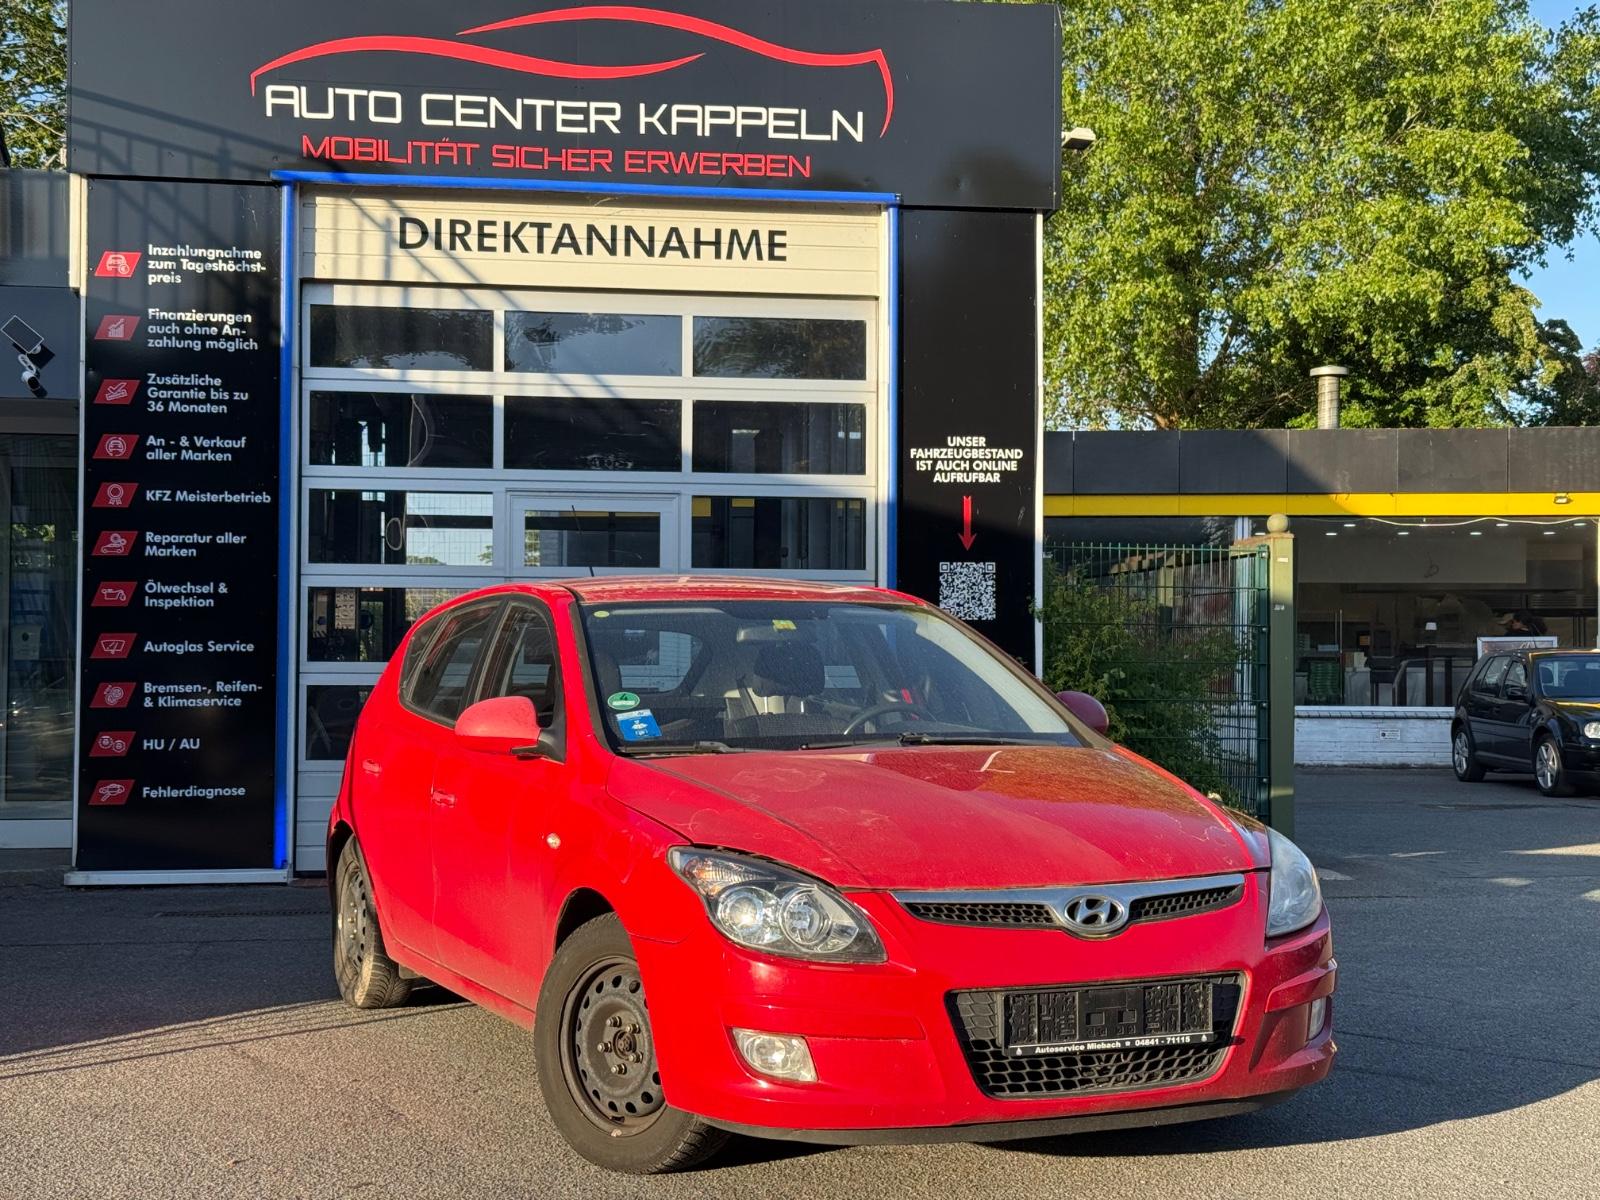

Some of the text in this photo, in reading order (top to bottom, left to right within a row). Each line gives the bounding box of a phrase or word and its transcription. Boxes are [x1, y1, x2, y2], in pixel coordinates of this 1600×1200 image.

[265, 84, 864, 142] AUTO CENTER KAPPELN
[302, 135, 810, 178] MOBILITÄT SICHER ERWERBEN
[399, 217, 788, 262] DIREKTANNAHME
[148, 244, 262, 259] Inzahlungnahme
[148, 259, 266, 272] zum Tageshöchst-
[148, 272, 181, 285] preis
[148, 308, 252, 324] Finanzierungen
[148, 323, 246, 336] auch ohne An-
[147, 337, 258, 352] zahlung möglich
[147, 373, 221, 386] Zusätzliche
[147, 388, 248, 400] Garantie bis zu
[147, 401, 227, 413] 36 Monaten
[146, 435, 165, 446] An
[180, 436, 190, 447] &
[194, 436, 247, 448] Verkauf
[947, 436, 986, 447] UNSER
[146, 449, 231, 461] aller Marken
[910, 449, 1023, 459] FAHRZEUGBESTAND
[916, 461, 1017, 471] IST AUCH ONLINE
[933, 473, 1000, 483] AUFRUFBAR
[146, 491, 271, 503] KFZ Meisterbetrieb
[145, 532, 246, 545] Reparatur aller
[145, 546, 196, 557] Marken
[145, 579, 228, 593] Ölwechsel &
[145, 596, 214, 609] Inspektion
[144, 641, 254, 654] Autoglas Service
[144, 681, 262, 694] Bremsen-, Reifen-
[144, 695, 242, 707] & Klimaservice
[143, 738, 200, 751] HU / AU
[143, 785, 245, 799] Fehlerdiagnose
[1035, 1045, 1085, 1053] Autoservice
[1087, 1042, 1121, 1050] Miebach
